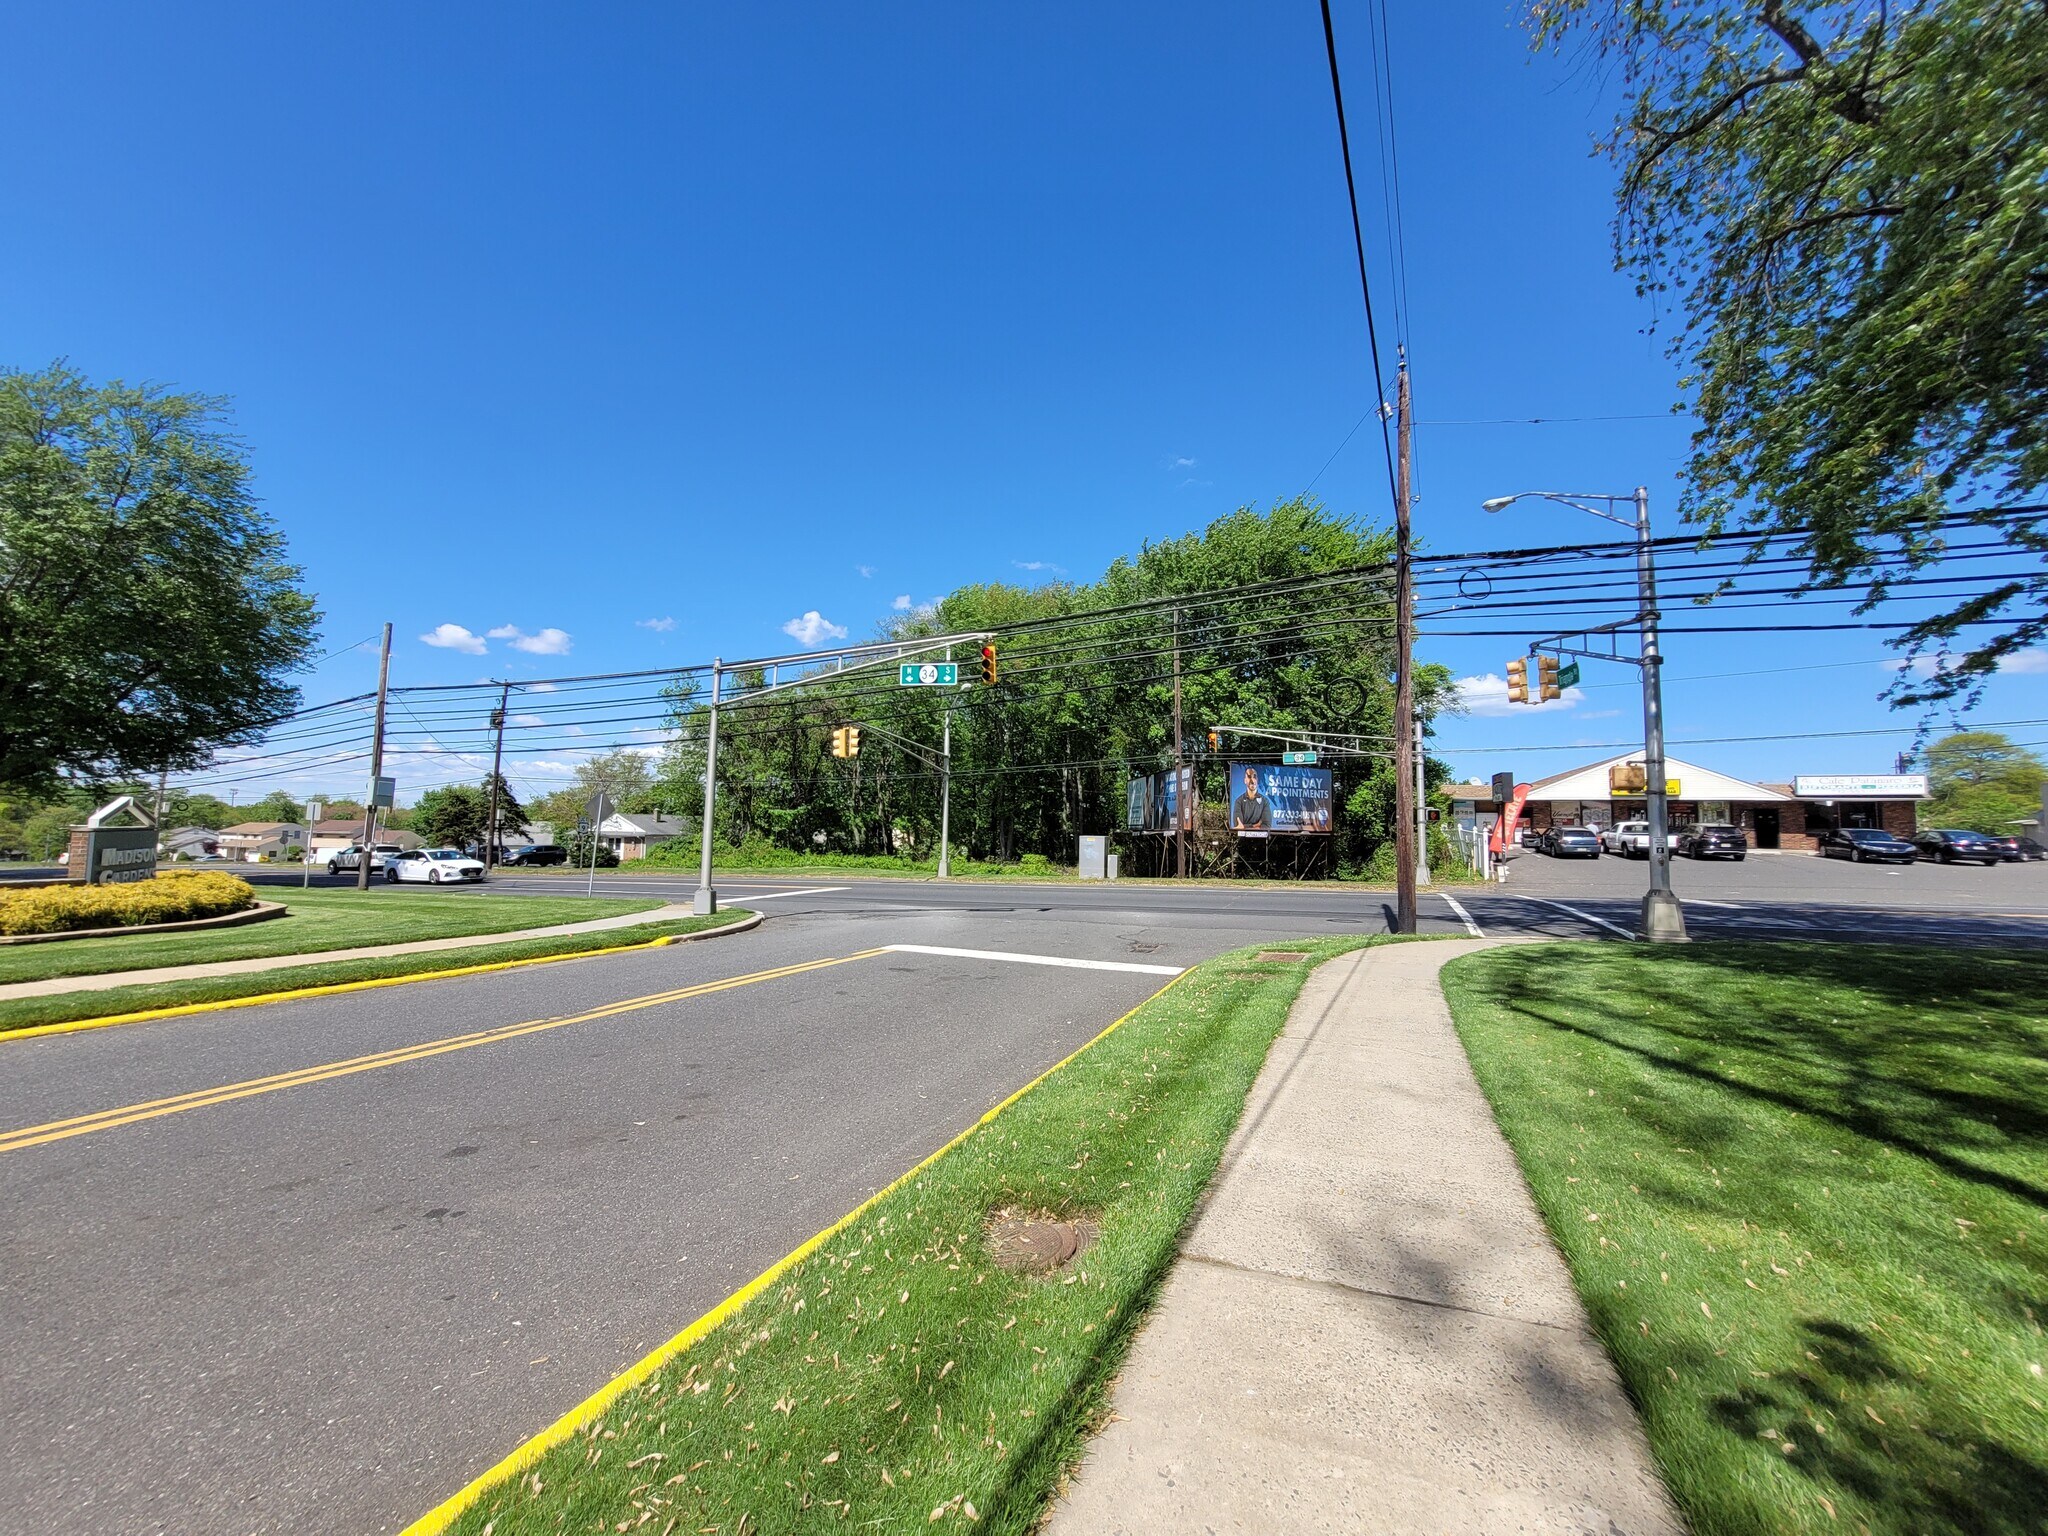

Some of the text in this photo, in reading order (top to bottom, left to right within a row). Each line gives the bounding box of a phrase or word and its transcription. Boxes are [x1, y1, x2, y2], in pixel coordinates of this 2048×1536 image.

[907, 666, 951, 680] N 34 S
[1268, 774, 1323, 789] SAME DAY
[1265, 786, 1329, 799] APPOINTMENTS
[101, 848, 157, 866] MADISON
